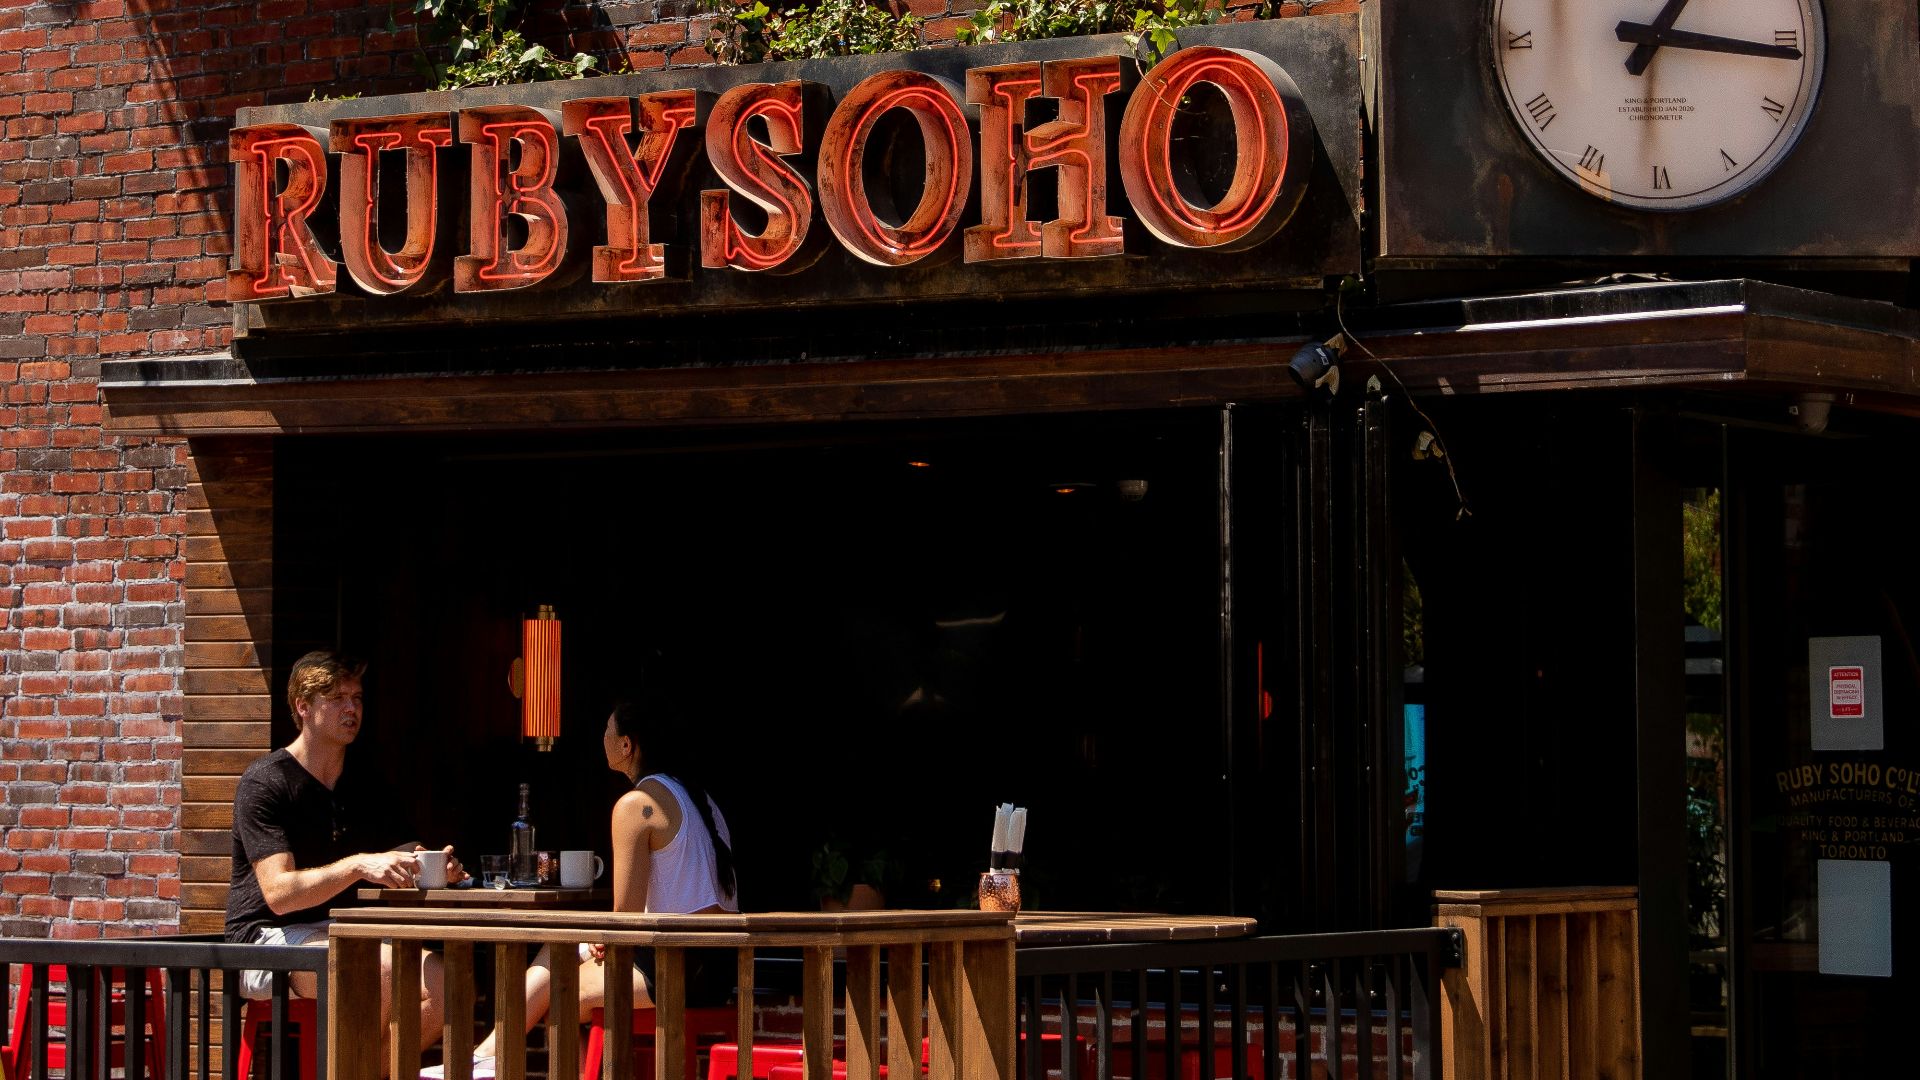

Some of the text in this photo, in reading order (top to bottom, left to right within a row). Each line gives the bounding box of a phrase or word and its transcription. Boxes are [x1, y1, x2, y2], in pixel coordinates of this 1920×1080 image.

[1525, 91, 1557, 132] VIII
[1577, 144, 1605, 177] VII
[1652, 165, 1672, 189] VI
[1776, 764, 1822, 793] RUBY
[1829, 762, 1880, 786] SOHO
[1790, 788, 1892, 807] MANUFACTURERS
[1828, 816, 1858, 828] FOOD
[1862, 817, 1870, 828] &
[1801, 830, 1904, 842] KING & PORTLAND
[1819, 844, 1887, 859] TORONTO
